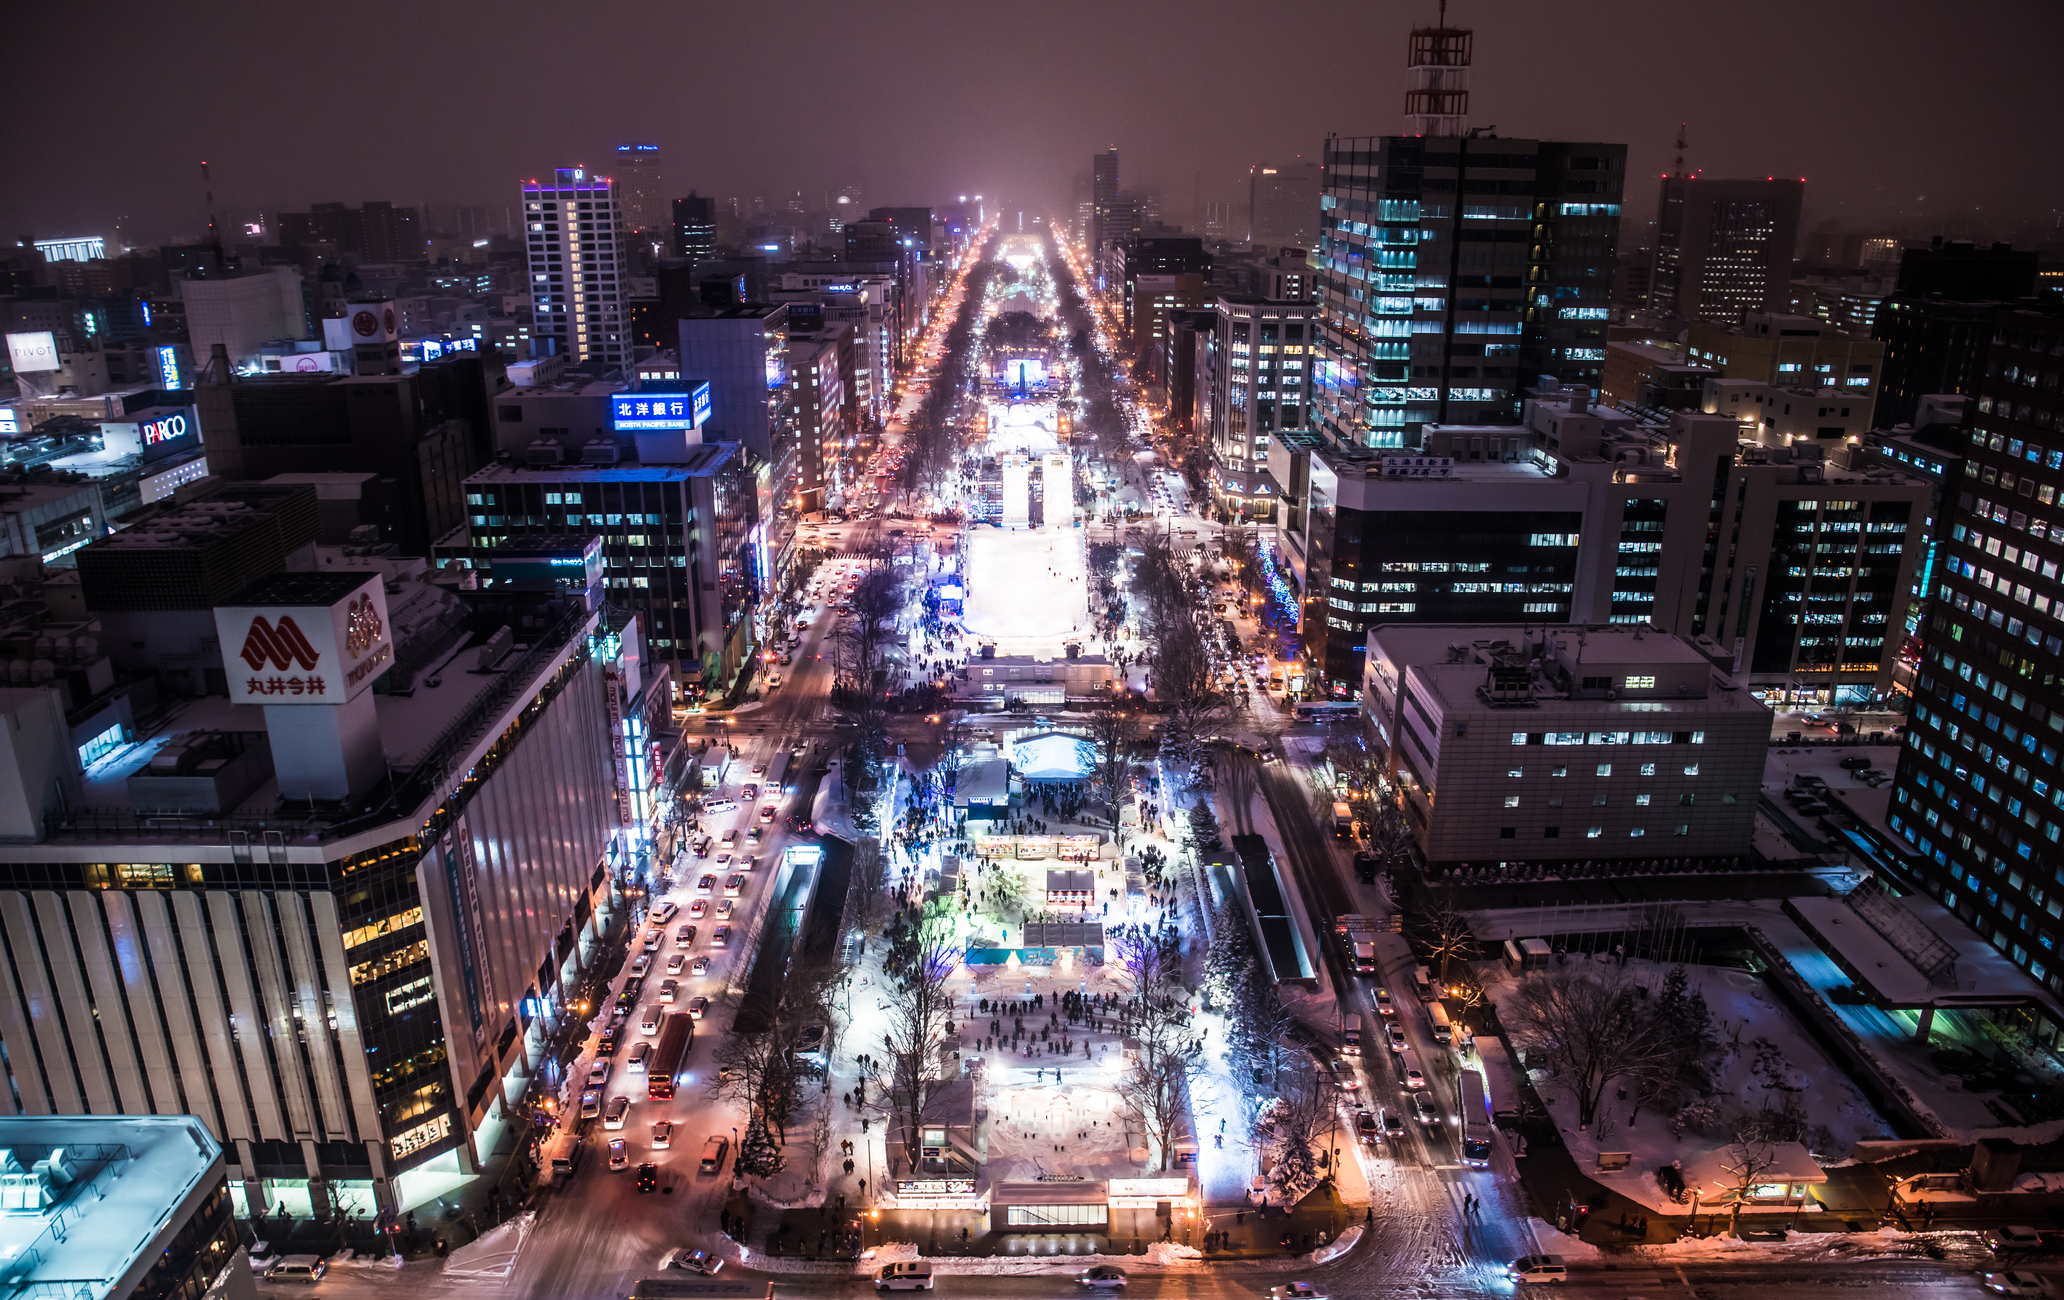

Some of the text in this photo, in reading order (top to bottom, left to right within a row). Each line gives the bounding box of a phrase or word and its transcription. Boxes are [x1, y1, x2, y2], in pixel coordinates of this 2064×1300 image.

[14, 346, 52, 357] PIVOT
[160, 348, 173, 383] イーオン
[618, 402, 684, 416] 北洋銀行
[143, 414, 186, 446] PARCO
[1387, 458, 1450, 466] 北海道新聞
[1388, 467, 1449, 475] 道新スポーツ
[246, 676, 326, 695] 丸井今井
